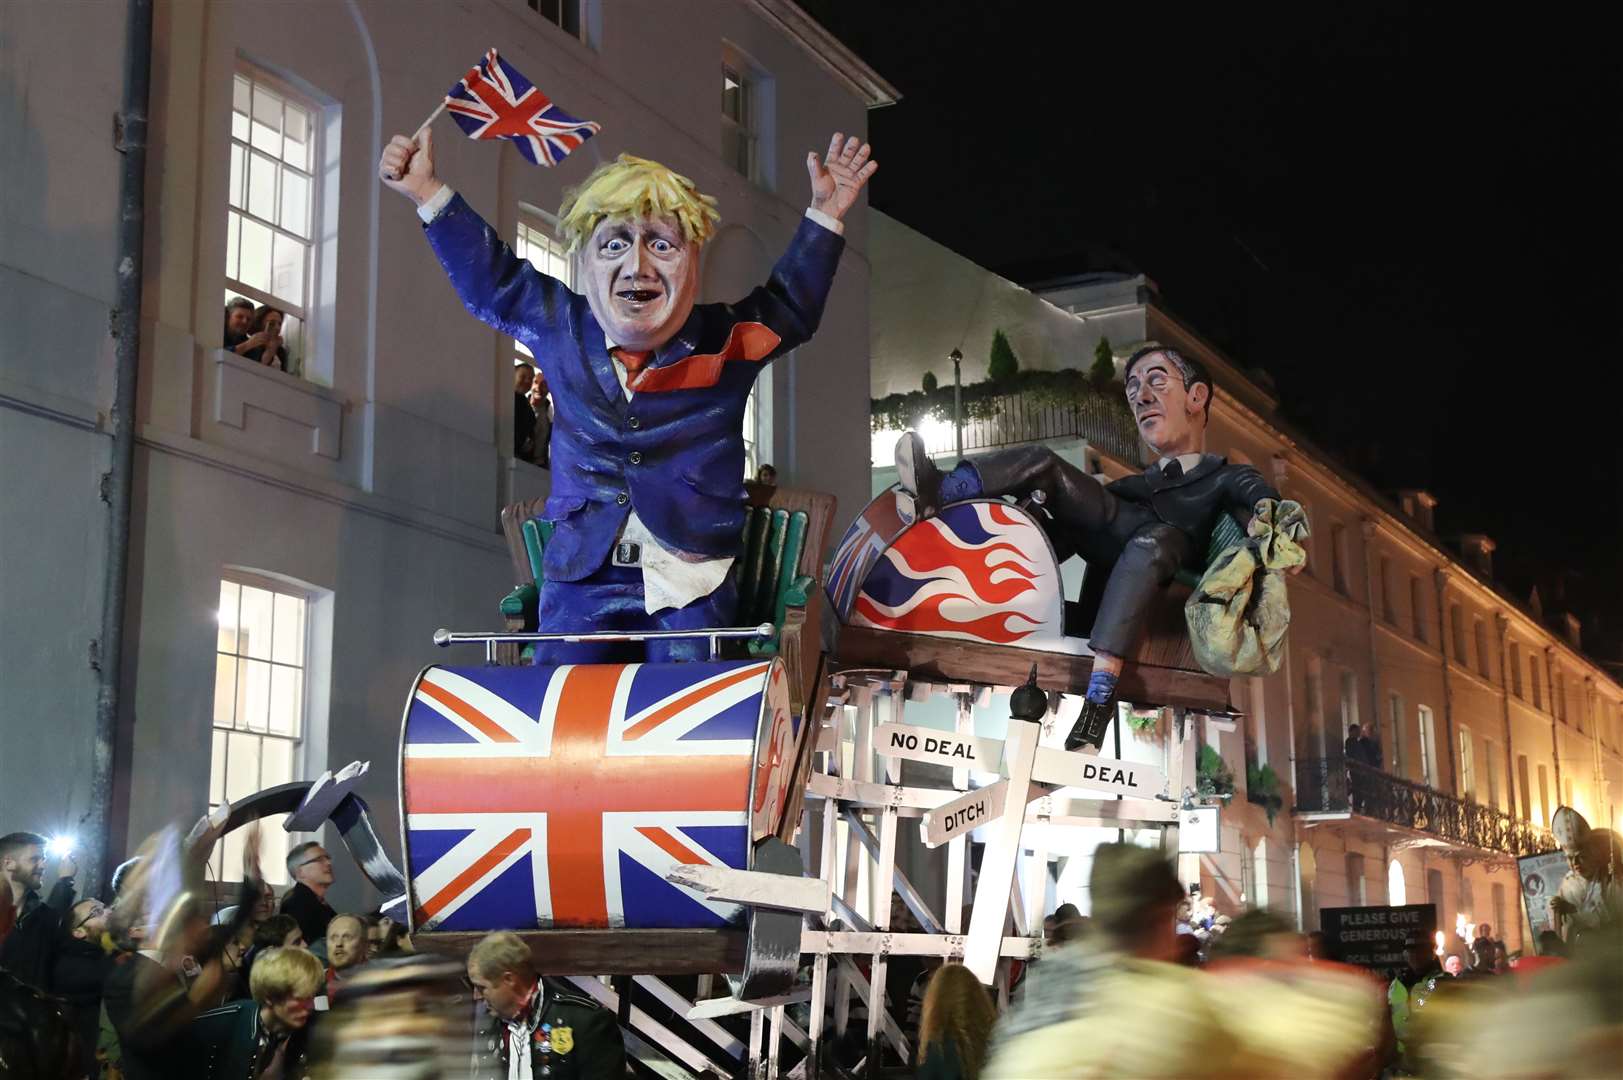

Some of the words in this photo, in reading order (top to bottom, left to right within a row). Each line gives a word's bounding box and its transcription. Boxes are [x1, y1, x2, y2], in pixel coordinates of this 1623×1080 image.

[890, 732, 918, 750] NO
[924, 738, 976, 760] DEAL
[1083, 763, 1138, 787] DEAL
[944, 800, 985, 832] DITCH
[1340, 912, 1387, 925] PLEASE
[1390, 911, 1420, 923] GIVE
[1339, 928, 1412, 942] GENEROUS
